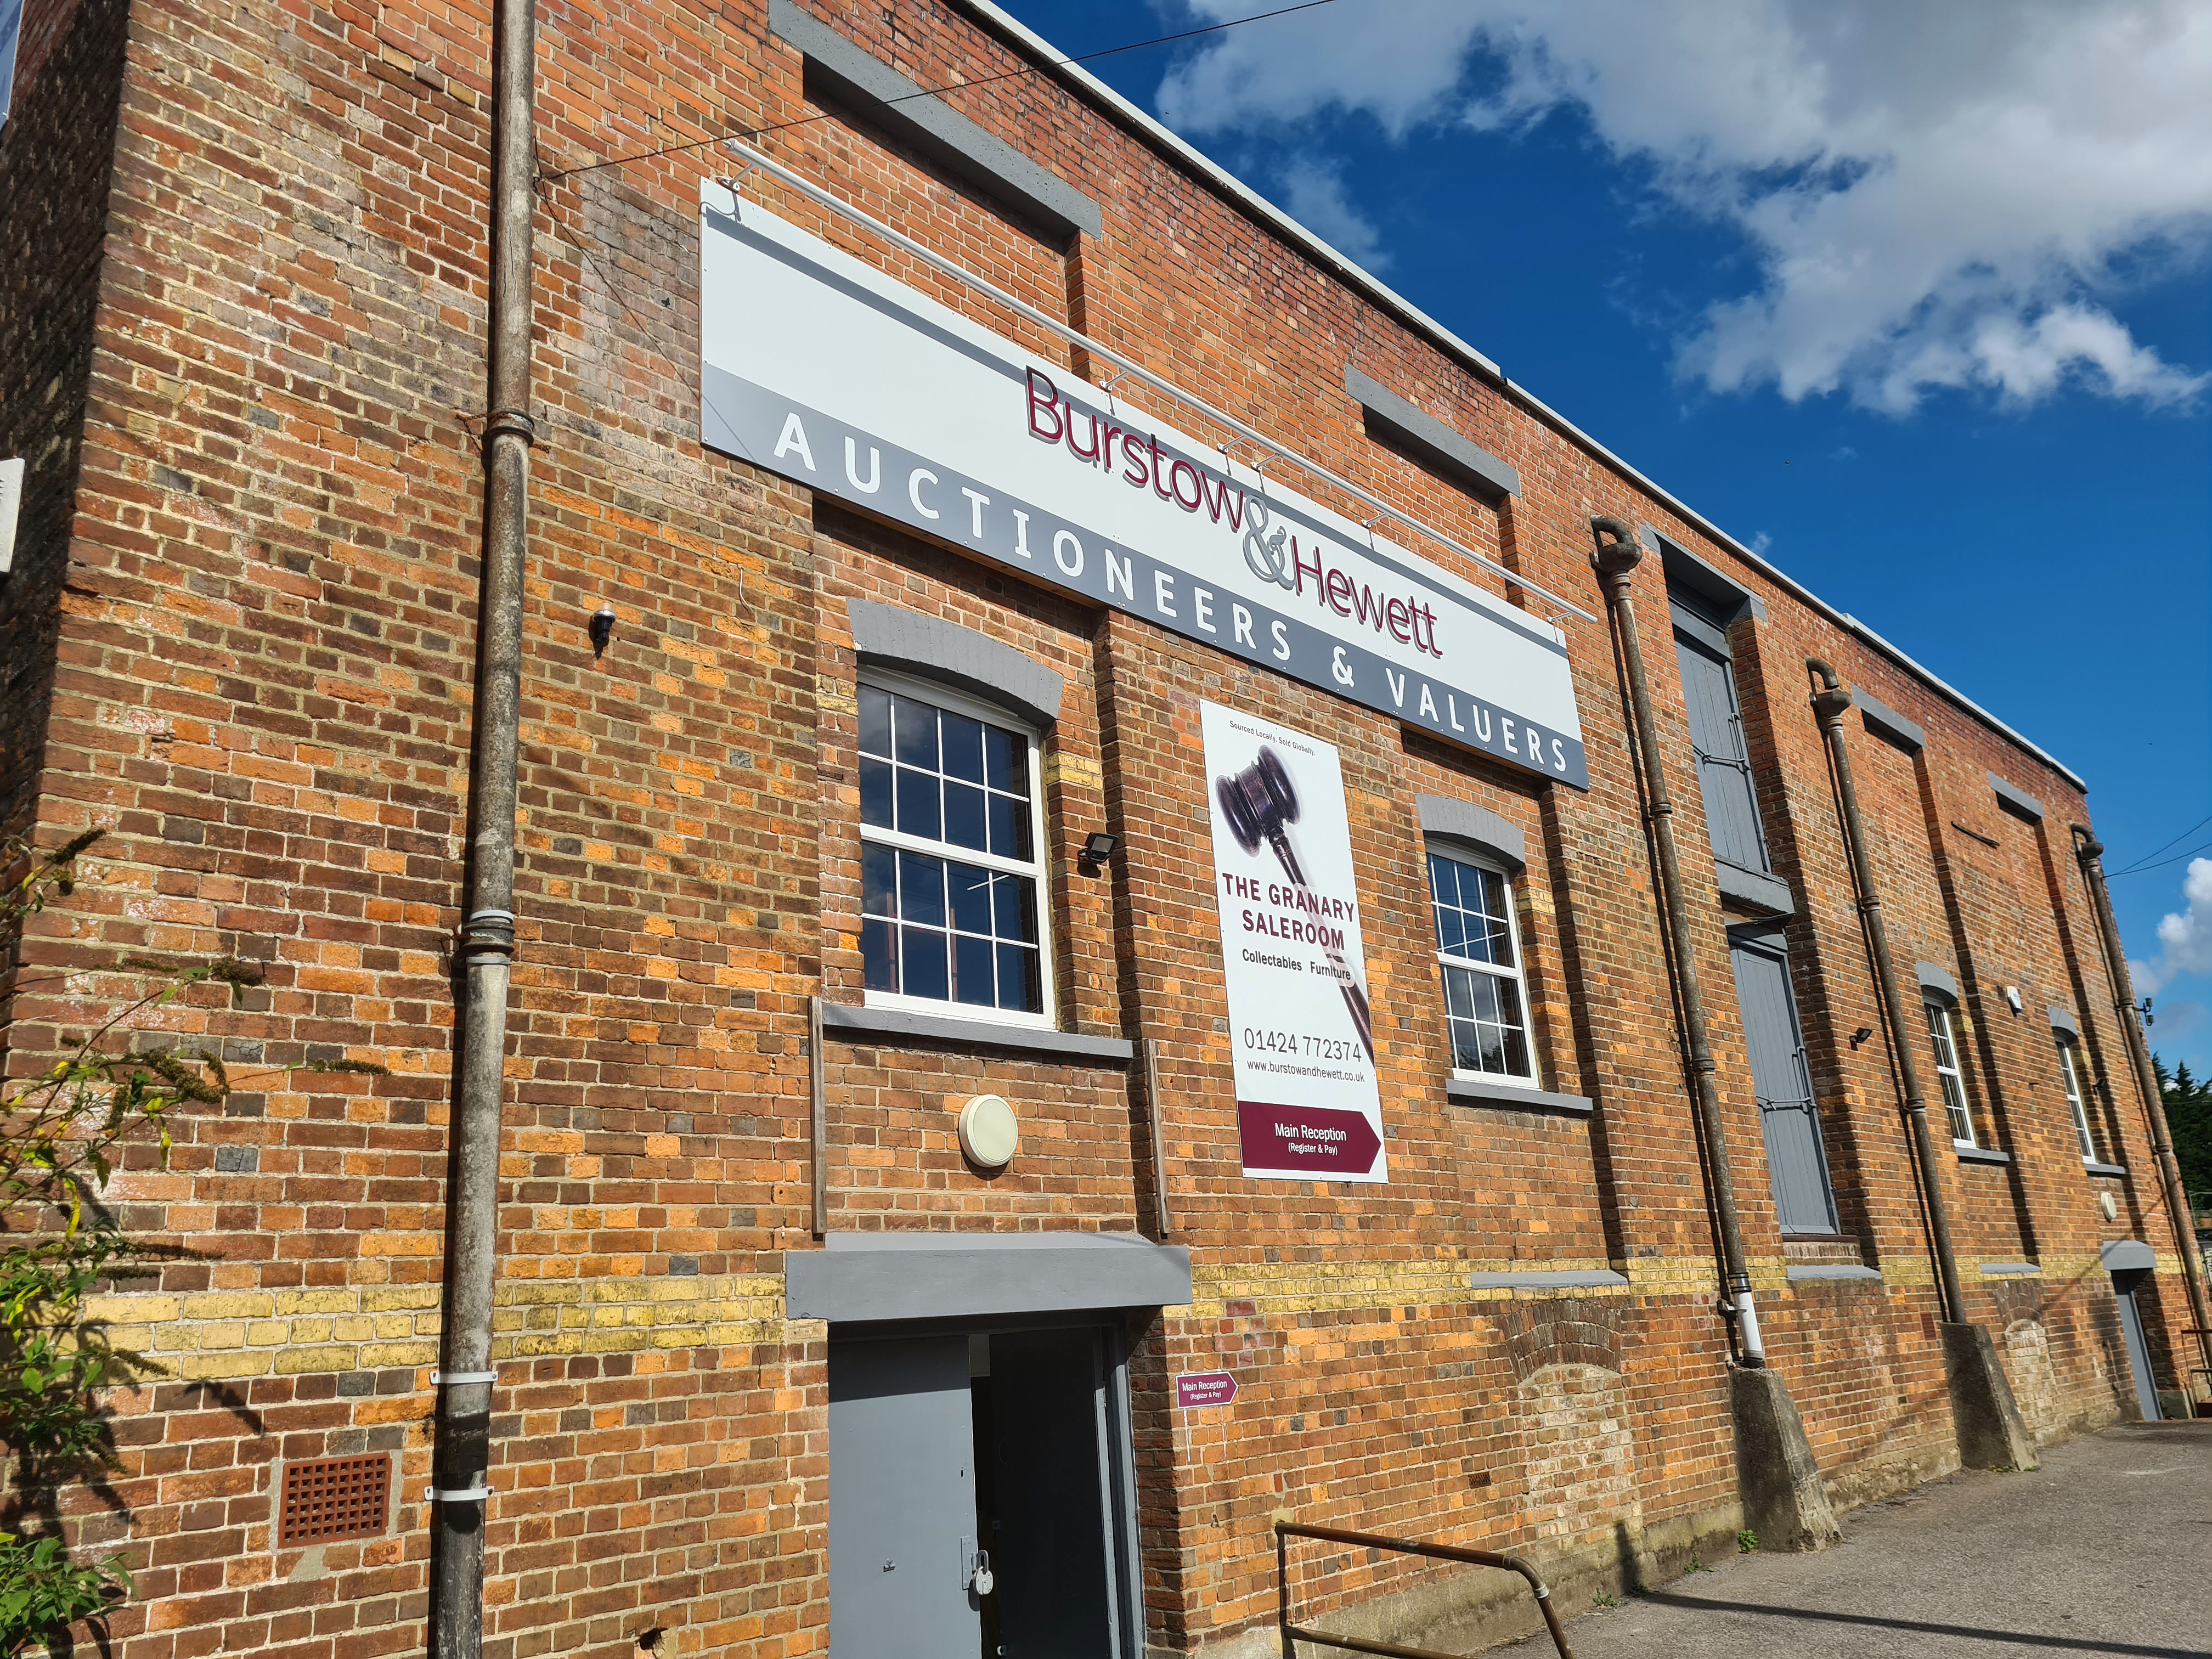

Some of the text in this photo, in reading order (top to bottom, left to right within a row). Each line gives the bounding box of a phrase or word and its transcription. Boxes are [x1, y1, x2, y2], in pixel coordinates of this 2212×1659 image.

[774, 412, 1567, 772] AUCTIONEERS & VALUERS
[1229, 720, 1254, 734] Sourced
[1279, 737, 1291, 747] Sold
[1293, 742, 1316, 756] Globally.
[1222, 873, 1354, 922] THE GRANARY
[1243, 910, 1345, 951] SALEROOM
[1242, 948, 1351, 980] Collectables Furniture
[1244, 1028, 1362, 1063] 01424 772374
[1247, 1060, 1365, 1083] www.burstowandhewett.co.uk
[1274, 1122, 1347, 1143] Main Reception
[1288, 1142, 1338, 1156] (Register & Pay)
[1182, 1380, 1227, 1391] Main Reception
